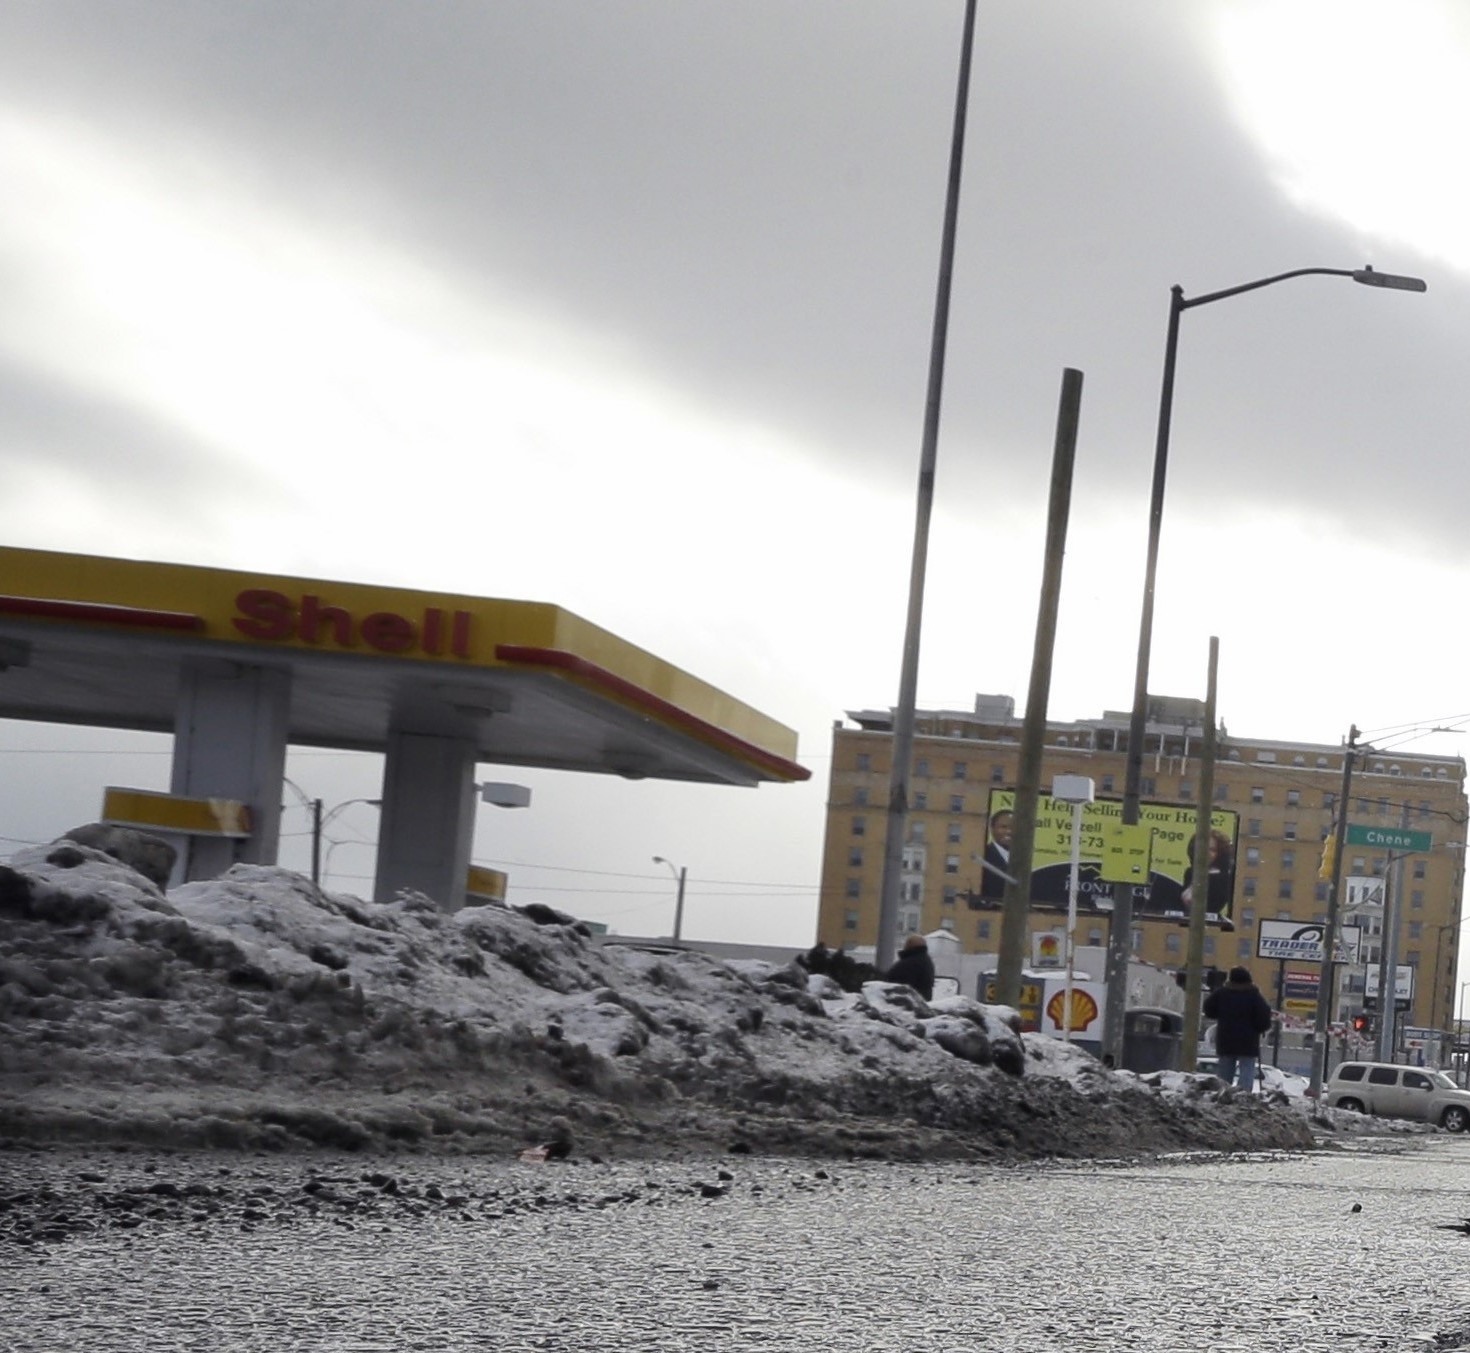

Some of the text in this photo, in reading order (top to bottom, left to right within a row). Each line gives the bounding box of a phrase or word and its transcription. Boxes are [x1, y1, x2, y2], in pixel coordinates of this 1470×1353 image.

[231, 588, 471, 658] Shell
[1084, 803, 1124, 818] Sellin
[1175, 811, 1225, 827] Hoe?
[1036, 818, 1051, 829] all
[1056, 819, 1102, 832] Vezell
[1366, 831, 1411, 846] Chene
[1261, 939, 1320, 951] TRADER
